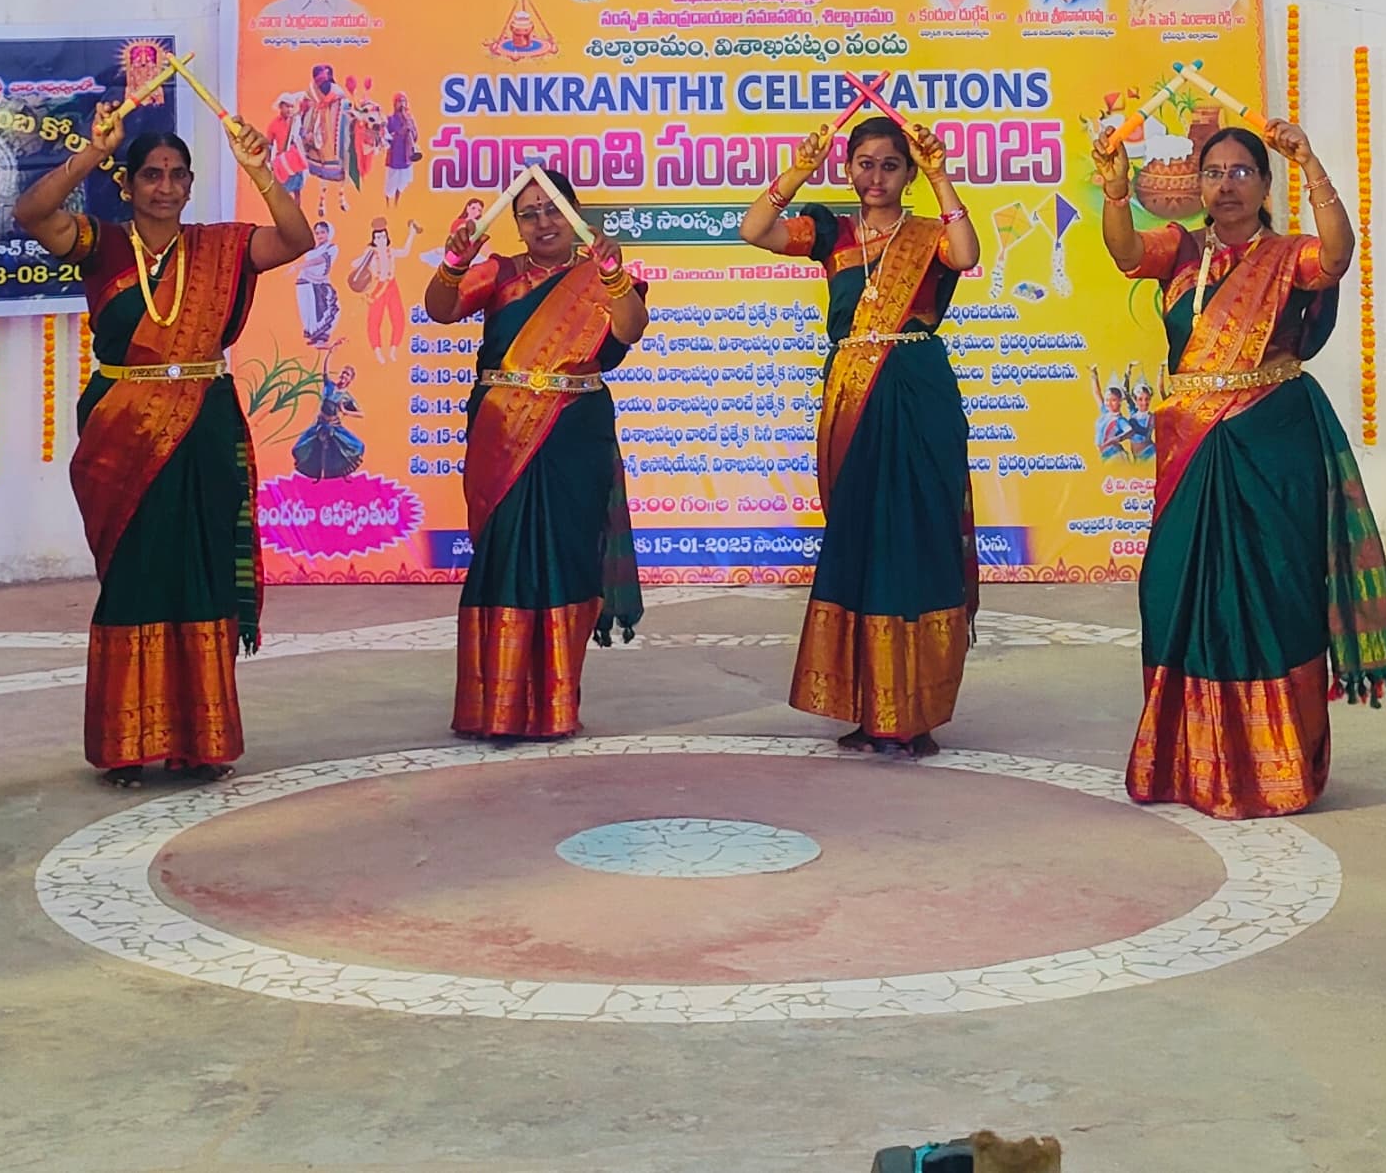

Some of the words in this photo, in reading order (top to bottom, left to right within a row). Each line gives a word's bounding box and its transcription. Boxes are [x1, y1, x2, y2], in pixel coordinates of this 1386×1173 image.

[822, 9, 893, 28] శిల్పారామం
[585, 33, 709, 64] శిల్పారామం,
[714, 32, 840, 63] విశాఖపట్నం
[846, 33, 908, 56] నందు
[444, 75, 723, 113] SANKRANTHI
[603, 207, 652, 238] ప్రత్యేక
[673, 270, 725, 280] మరియు
[714, 303, 746, 321] వారిచే
[748, 304, 777, 327] ప్రత్యేక
[722, 362, 754, 381] వారిచే
[756, 363, 785, 387] ప్రత్యేక
[721, 391, 754, 411] వారిచే
[756, 391, 786, 417] ప్రత్యేక
[686, 423, 718, 442] వారిచే
[720, 423, 750, 448] ప్రత్యేక
[777, 452, 810, 473] వారిచే
[737, 494, 788, 512] నుండి
[653, 535, 752, 554] 15-01-2025
